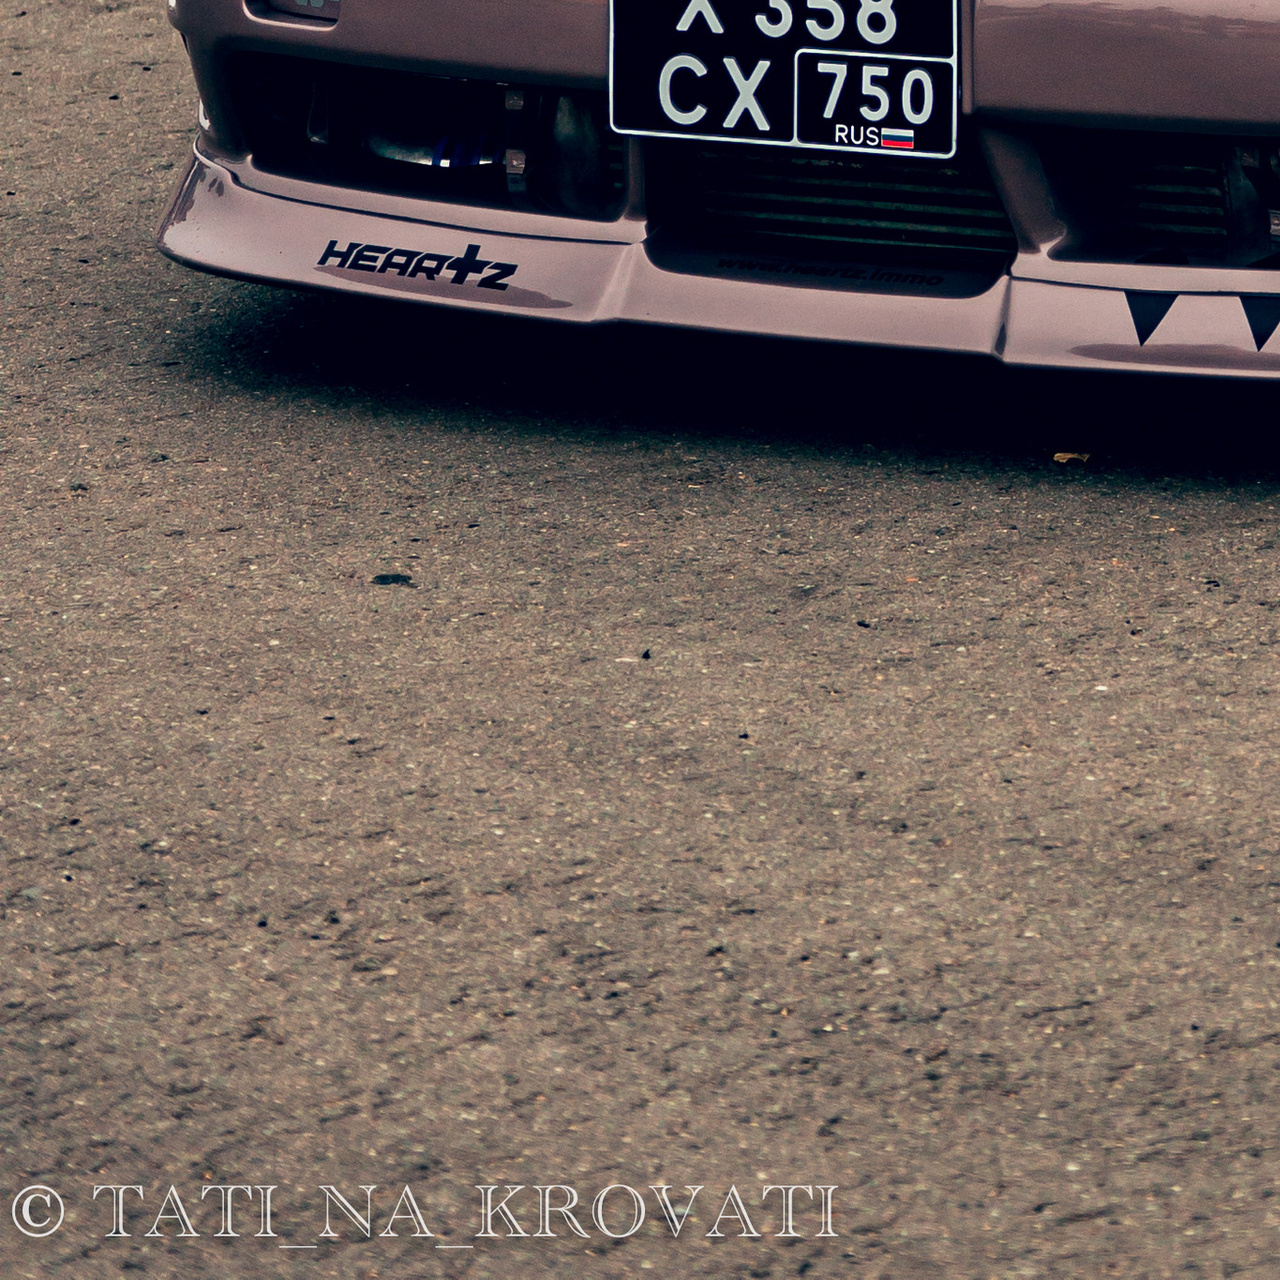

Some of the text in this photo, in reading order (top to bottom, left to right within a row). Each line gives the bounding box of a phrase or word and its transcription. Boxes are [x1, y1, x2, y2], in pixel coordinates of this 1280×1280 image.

[658, 54, 935, 132] CX 750
[835, 124, 880, 146] RUS
